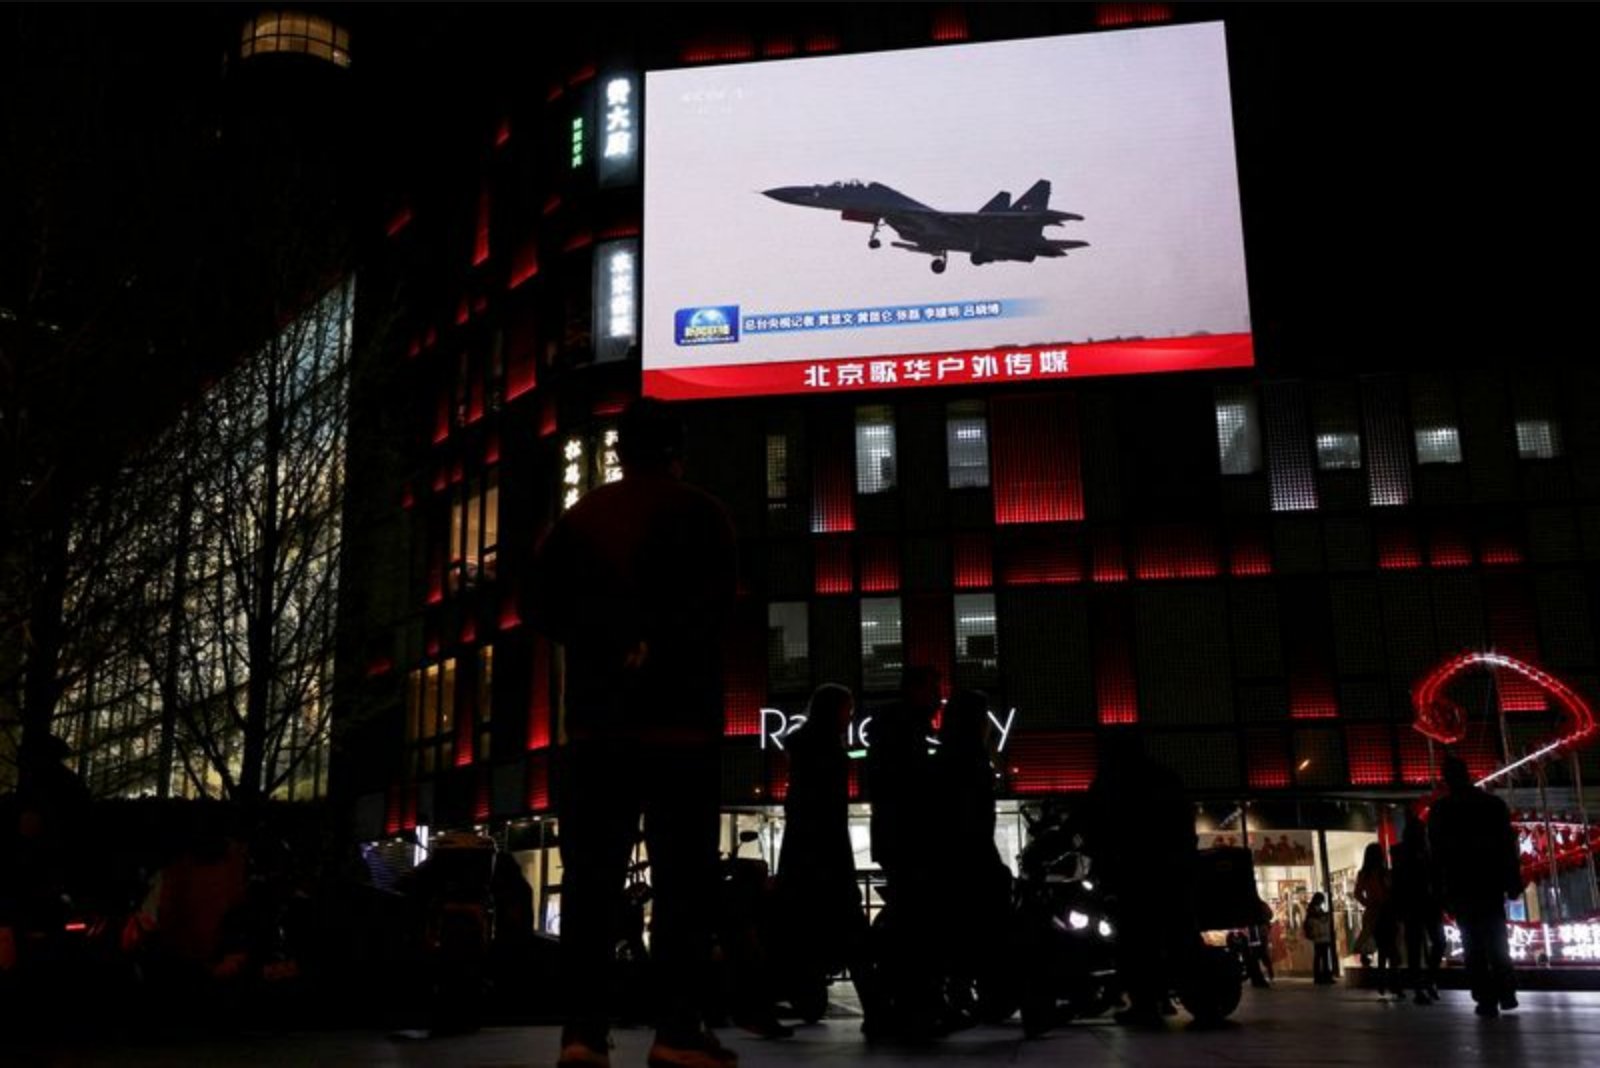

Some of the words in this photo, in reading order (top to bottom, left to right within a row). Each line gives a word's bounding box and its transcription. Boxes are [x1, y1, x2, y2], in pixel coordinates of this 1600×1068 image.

[803, 350, 1068, 387] 北京歌华户外传媒
